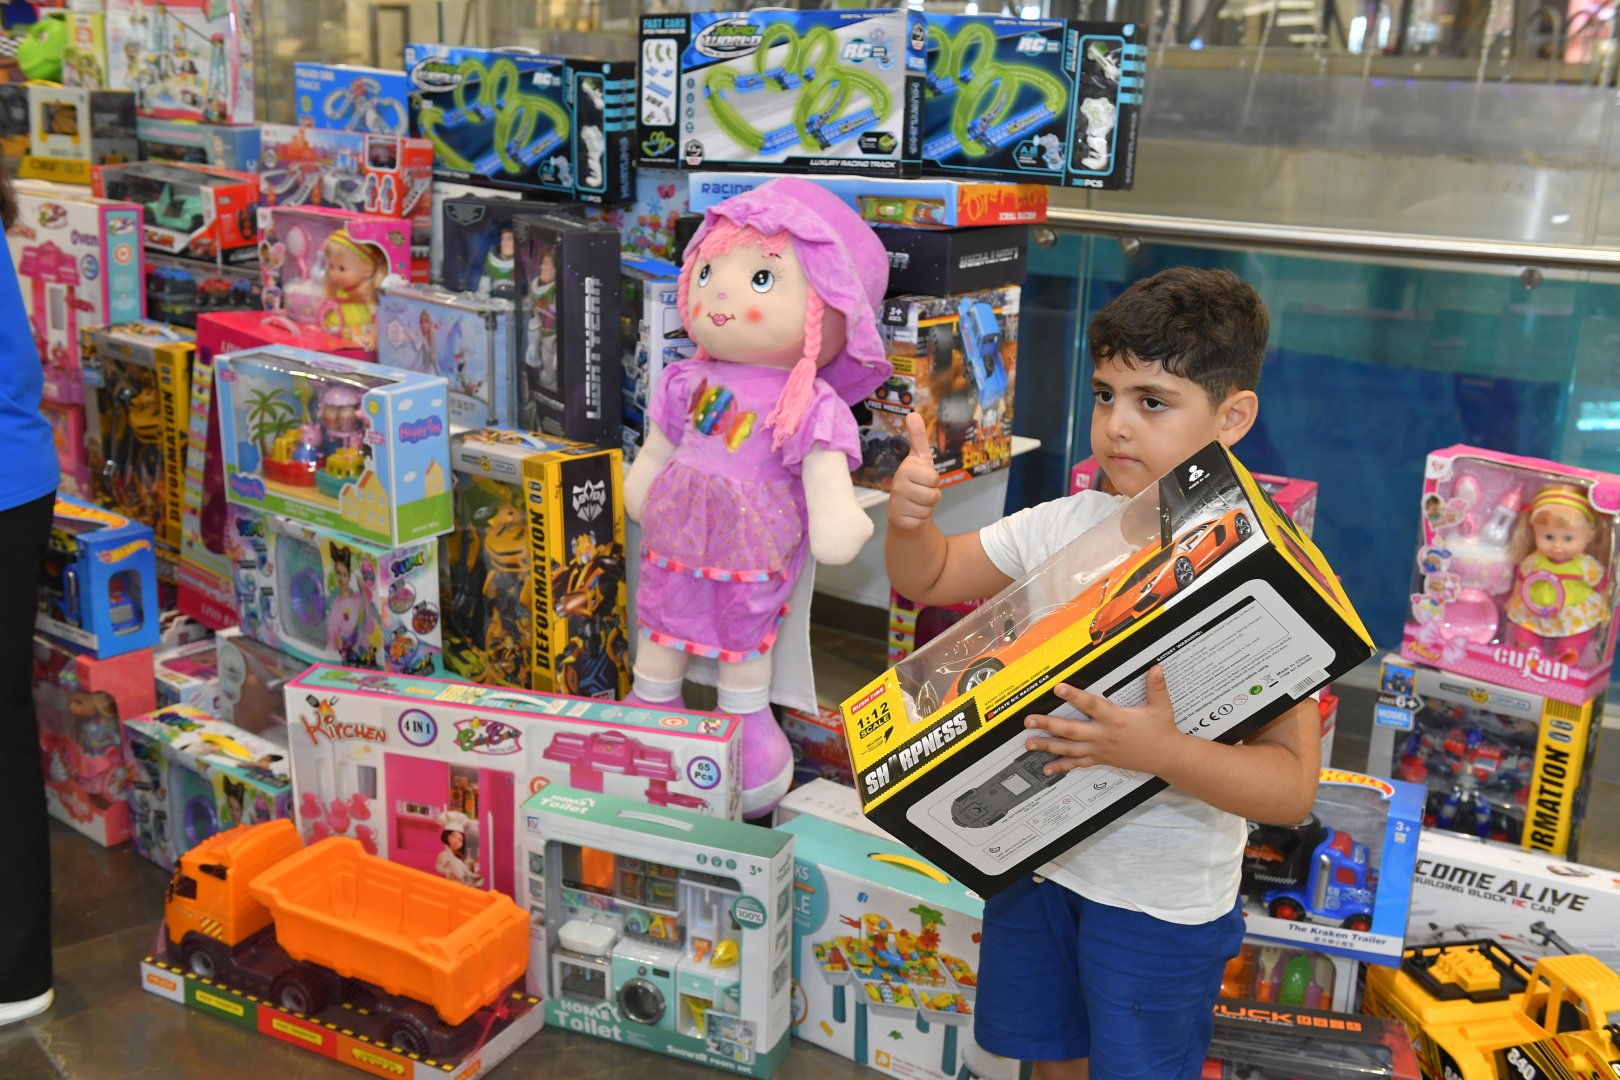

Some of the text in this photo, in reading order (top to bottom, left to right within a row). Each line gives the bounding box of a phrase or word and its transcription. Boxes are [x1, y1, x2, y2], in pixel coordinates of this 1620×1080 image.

[702, 35, 764, 47] WORLD
[1017, 37, 1048, 51] RC
[843, 43, 871, 58] RC
[810, 159, 896, 169] LUXURY RACING TRACK
[529, 508, 550, 671] DEFORMATION
[1155, 647, 1176, 661] BATTERY
[1018, 682, 1039, 696] RACING
[1037, 674, 1049, 683] CAR
[852, 686, 885, 712] RUSH FIRE
[1396, 694, 1418, 709] 6+
[857, 702, 889, 729] 1:12
[404, 719, 431, 734] 4 IN 1
[861, 714, 890, 738] SCALE
[697, 762, 711, 771] 65
[694, 771, 714, 782] Pcs
[540, 797, 590, 815] Toilet
[1395, 821, 1412, 833] 3+
[749, 865, 763, 876] 3+
[1414, 858, 1590, 912] COME ALIVE
[1467, 888, 1508, 904] BLOCK
[1511, 898, 1528, 909] RC
[1530, 902, 1556, 915] CAR
[737, 910, 762, 922] 100%
[1288, 923, 1308, 934] The
[1310, 927, 1349, 940] Kraken
[1351, 933, 1387, 946] Trailer
[554, 1009, 623, 1042] Toilet
[709, 1057, 735, 1070] room
[737, 1064, 753, 1075] set
[1507, 1048, 1536, 1080] 840
